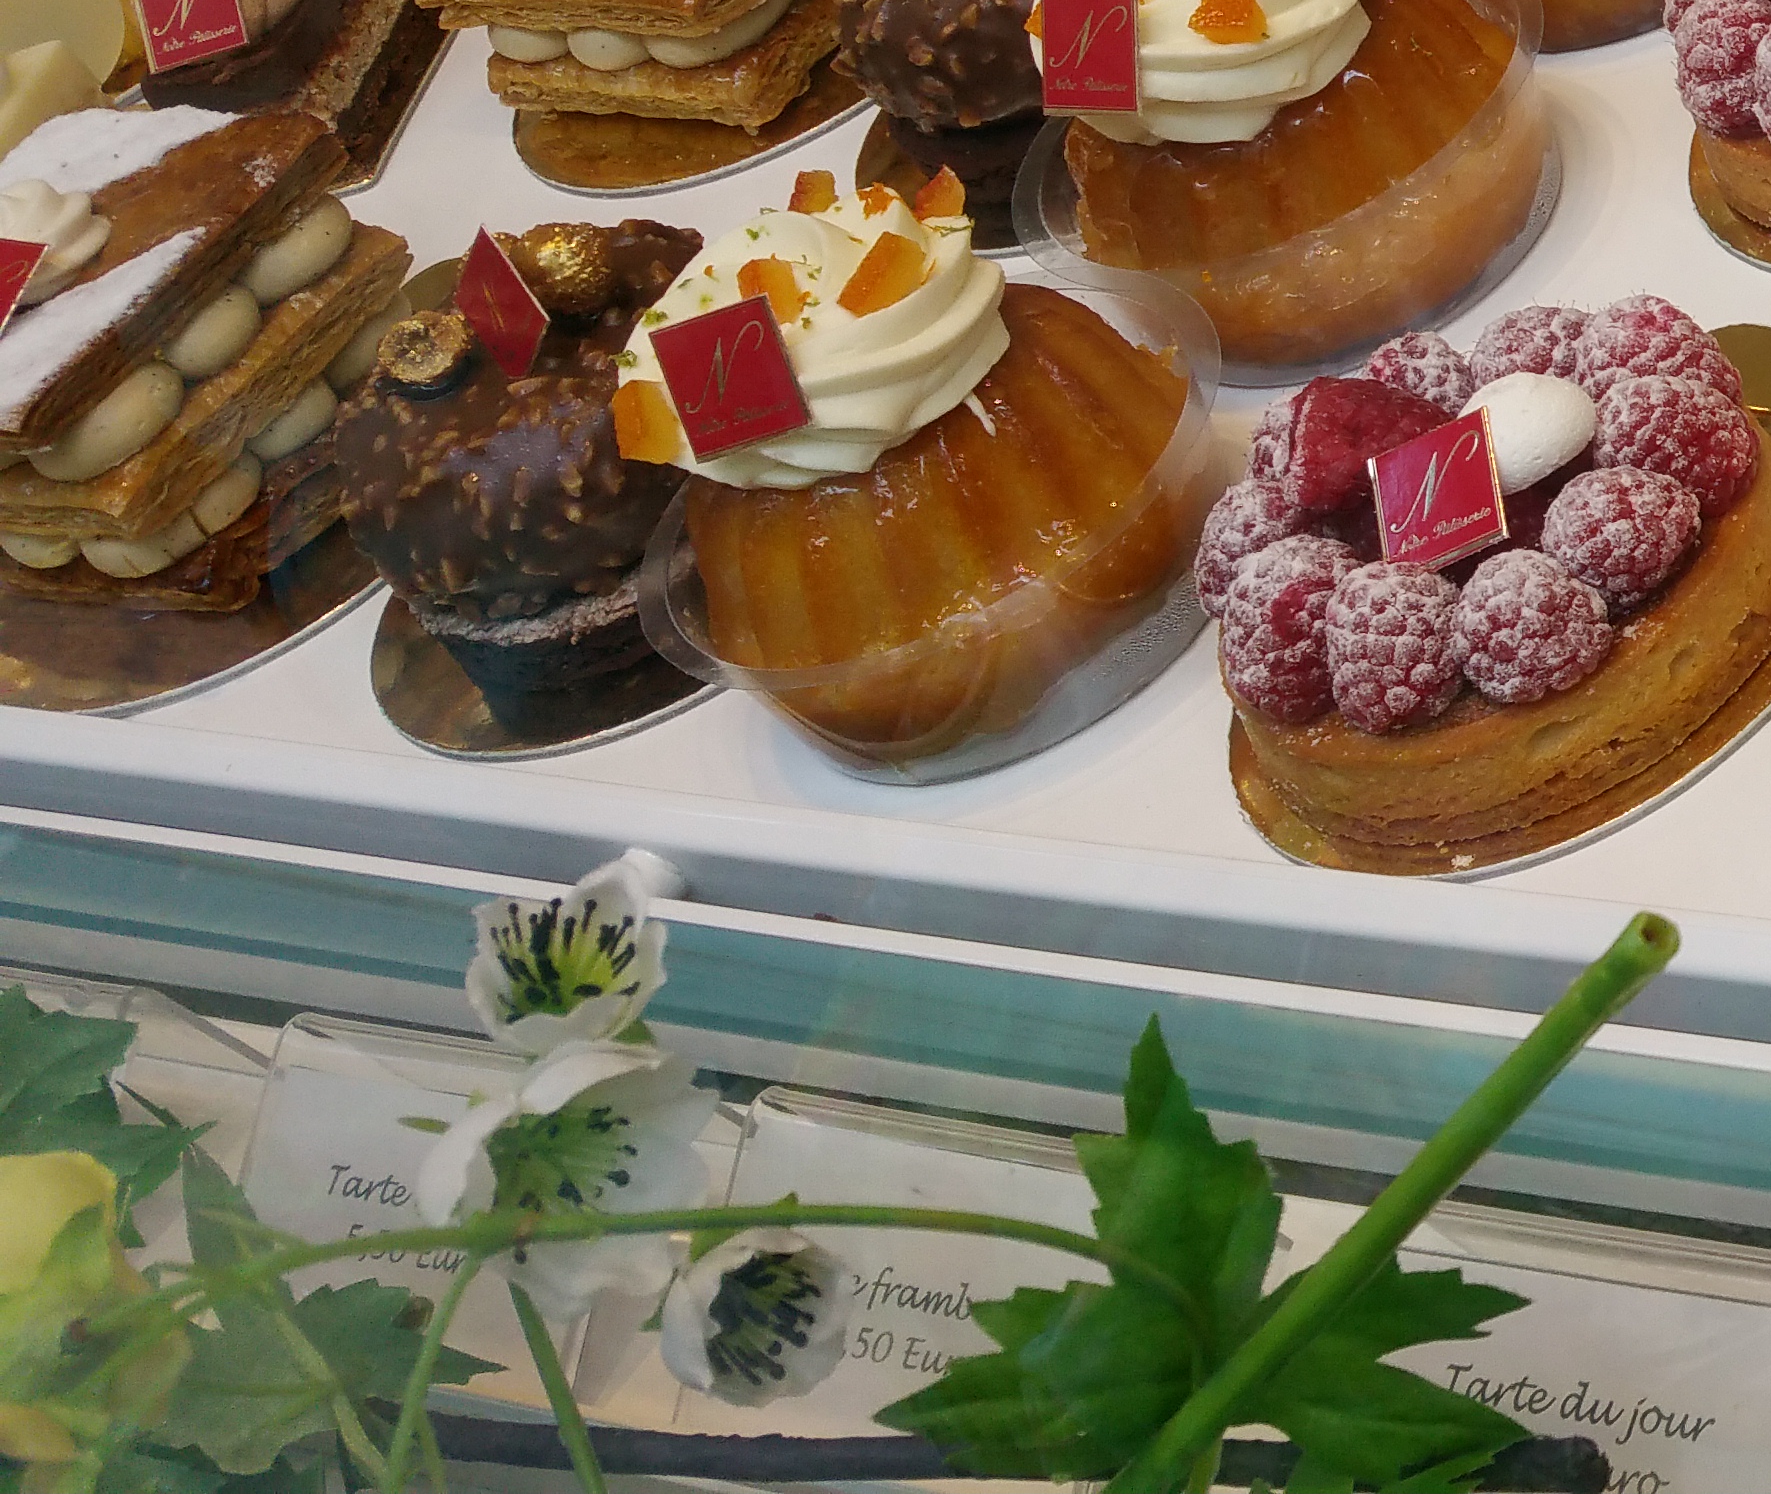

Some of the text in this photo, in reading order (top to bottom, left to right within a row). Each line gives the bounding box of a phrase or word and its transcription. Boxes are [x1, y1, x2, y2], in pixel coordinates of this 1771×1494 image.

[1049, 5, 1128, 69] N
[685, 320, 764, 414] N
[1391, 430, 1481, 533] N
[328, 1165, 412, 1206] Tarte
[1447, 1363, 1716, 1445] Tarte du jour
[1603, 1466, 1670, 1494] uro
